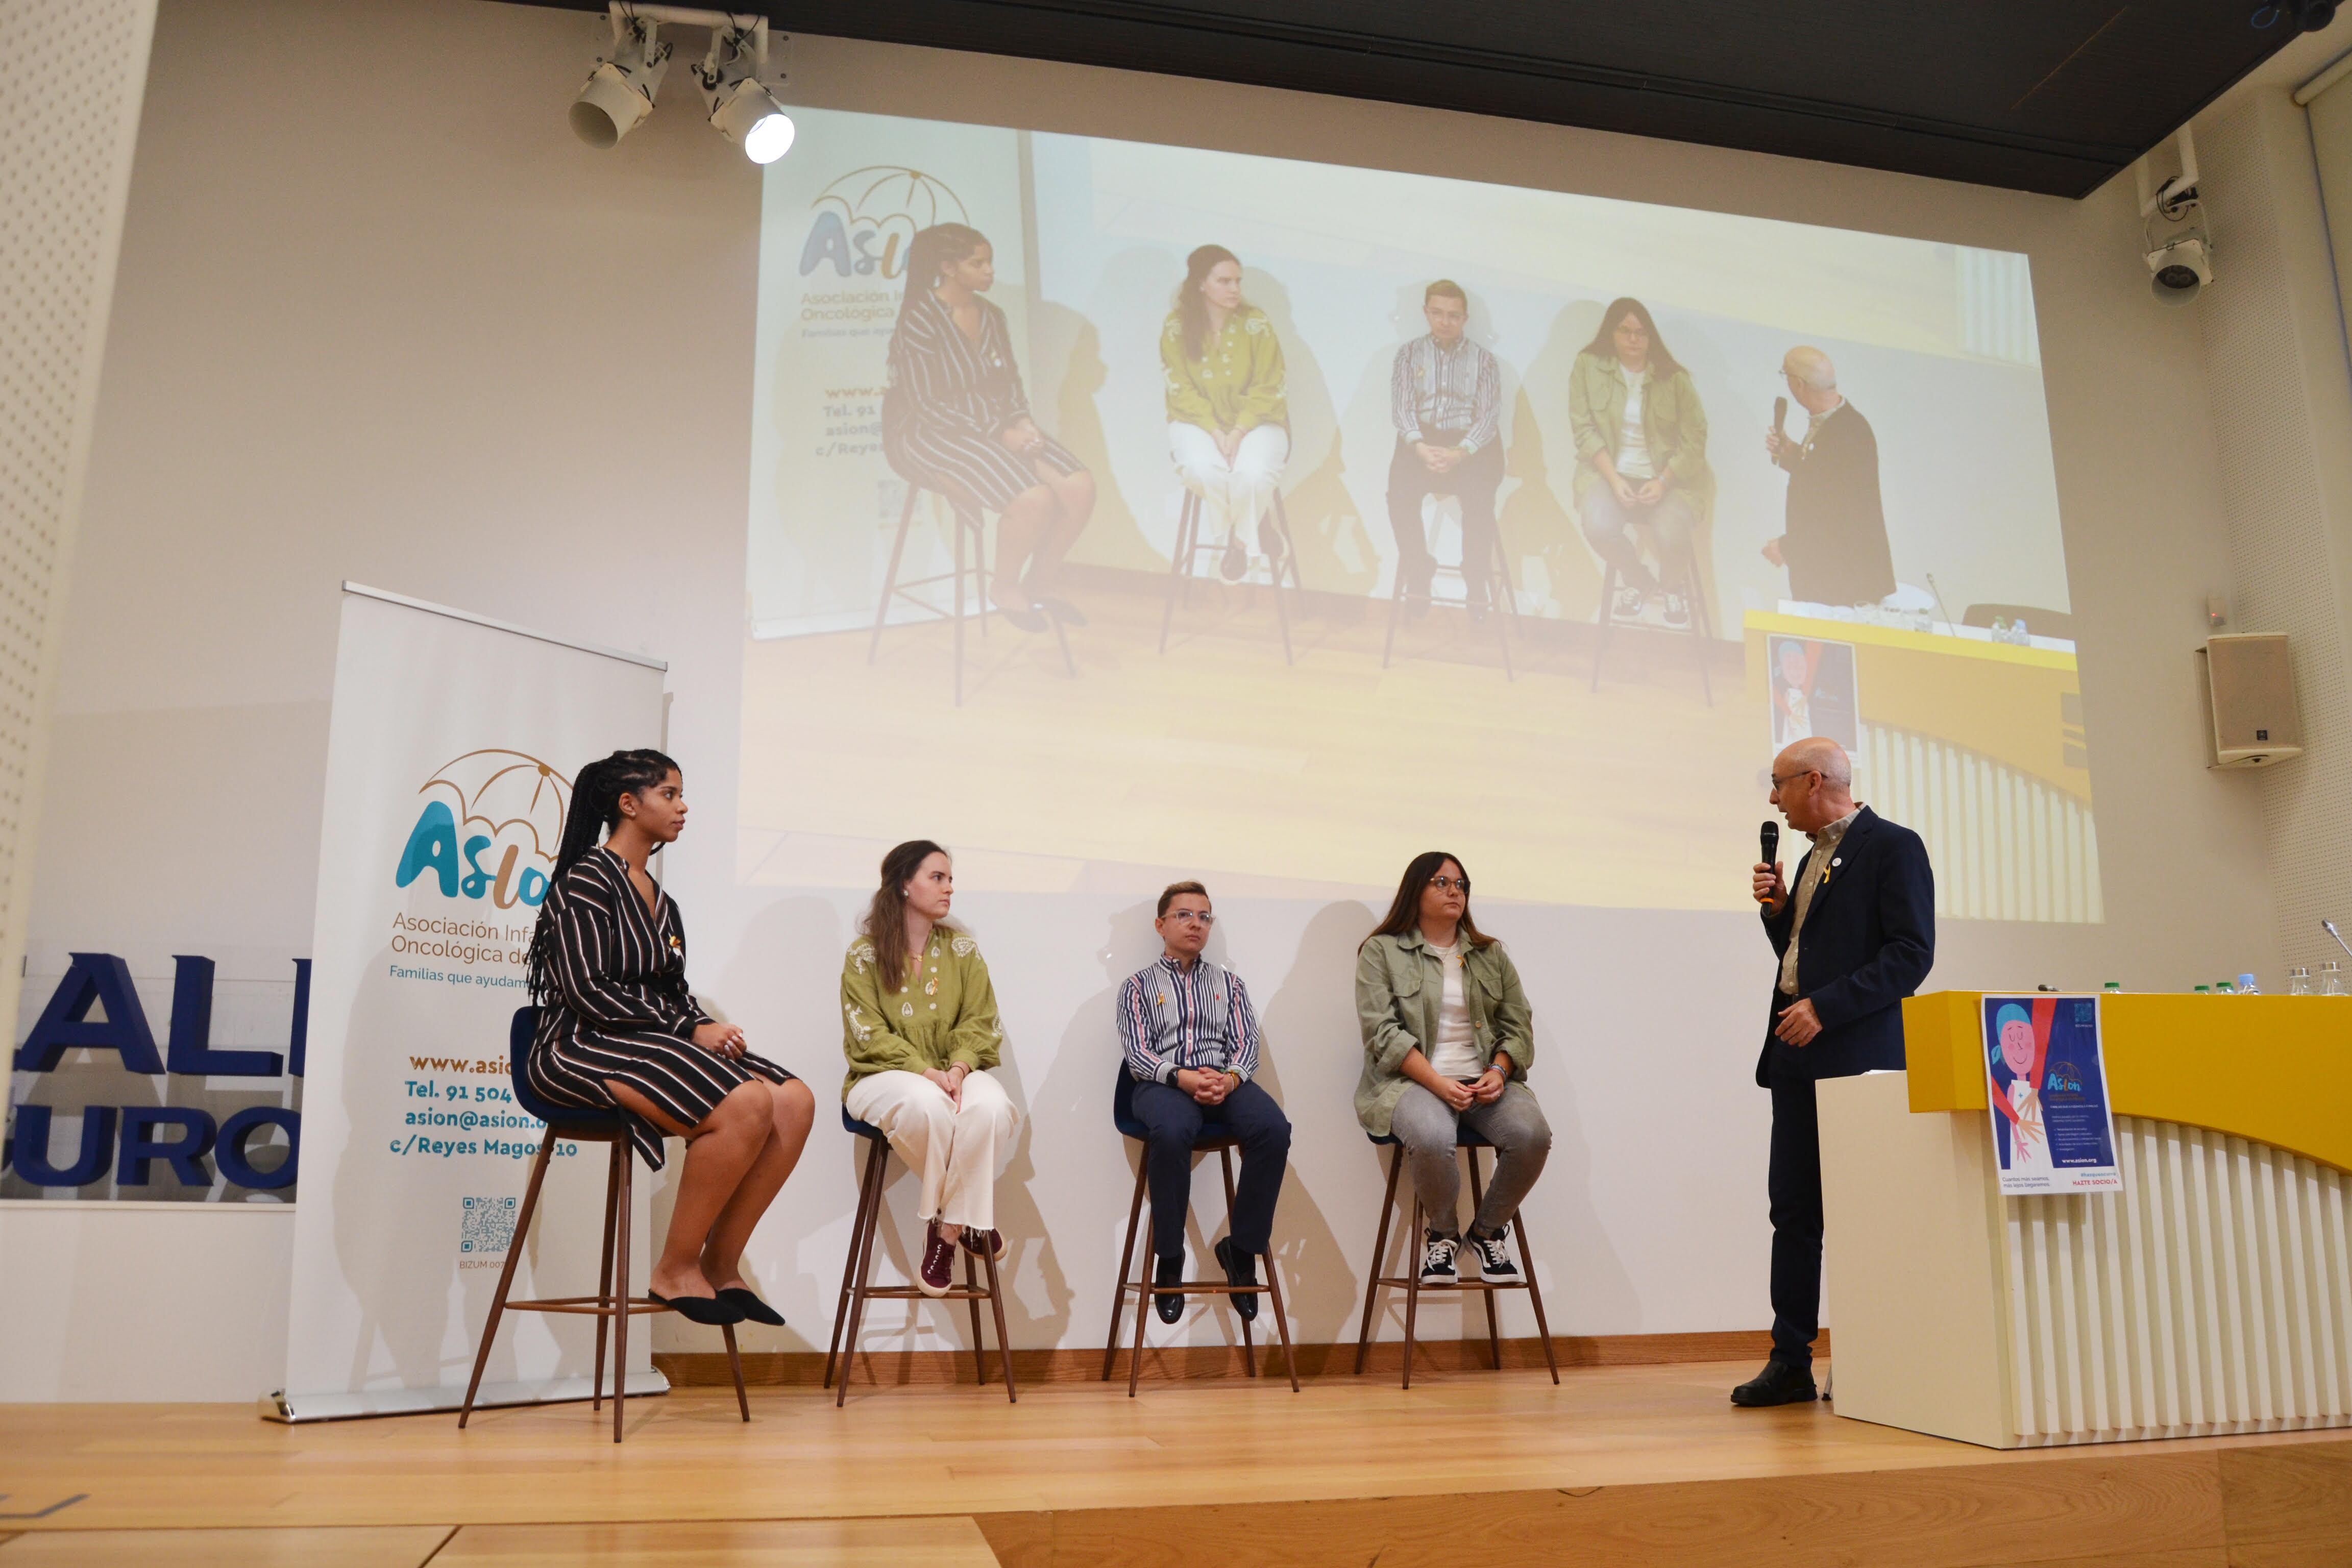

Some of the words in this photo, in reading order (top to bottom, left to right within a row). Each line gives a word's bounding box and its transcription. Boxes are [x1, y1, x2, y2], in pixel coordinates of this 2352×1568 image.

[799, 210, 910, 279] Asi
[801, 306, 894, 322] Oncológica
[393, 912, 498, 940] Asociación
[392, 935, 503, 964] Oncológica
[390, 965, 444, 981] Familias
[448, 973, 472, 985] que
[405, 1080, 439, 1098] Tel.
[446, 1086, 469, 1101] 91
[475, 1087, 512, 1104] 504
[3, 1105, 301, 1190] URO
[389, 1134, 477, 1158] c/Reyes
[556, 1144, 577, 1157] 10
[459, 1261, 487, 1269] BIZUM
